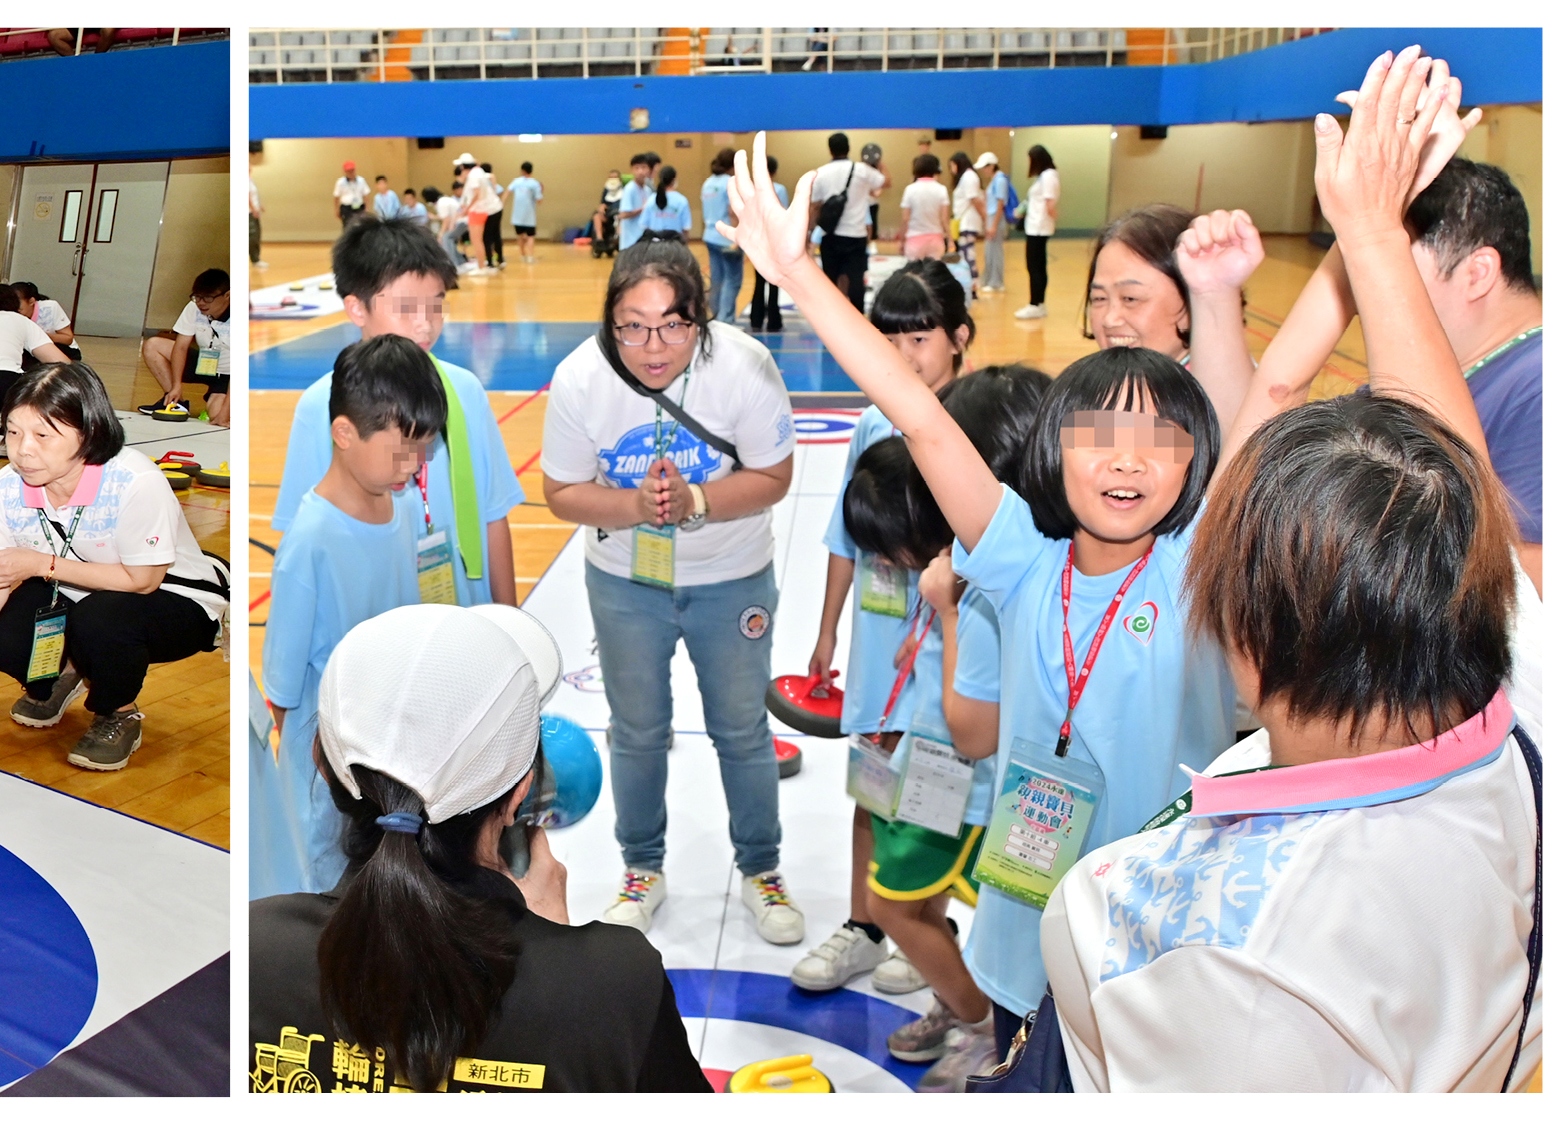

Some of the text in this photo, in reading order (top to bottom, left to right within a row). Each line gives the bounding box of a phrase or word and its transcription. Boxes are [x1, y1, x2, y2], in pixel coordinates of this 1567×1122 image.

[1023, 804, 1063, 829] 運動會
[468, 1063, 532, 1085] 新北市
